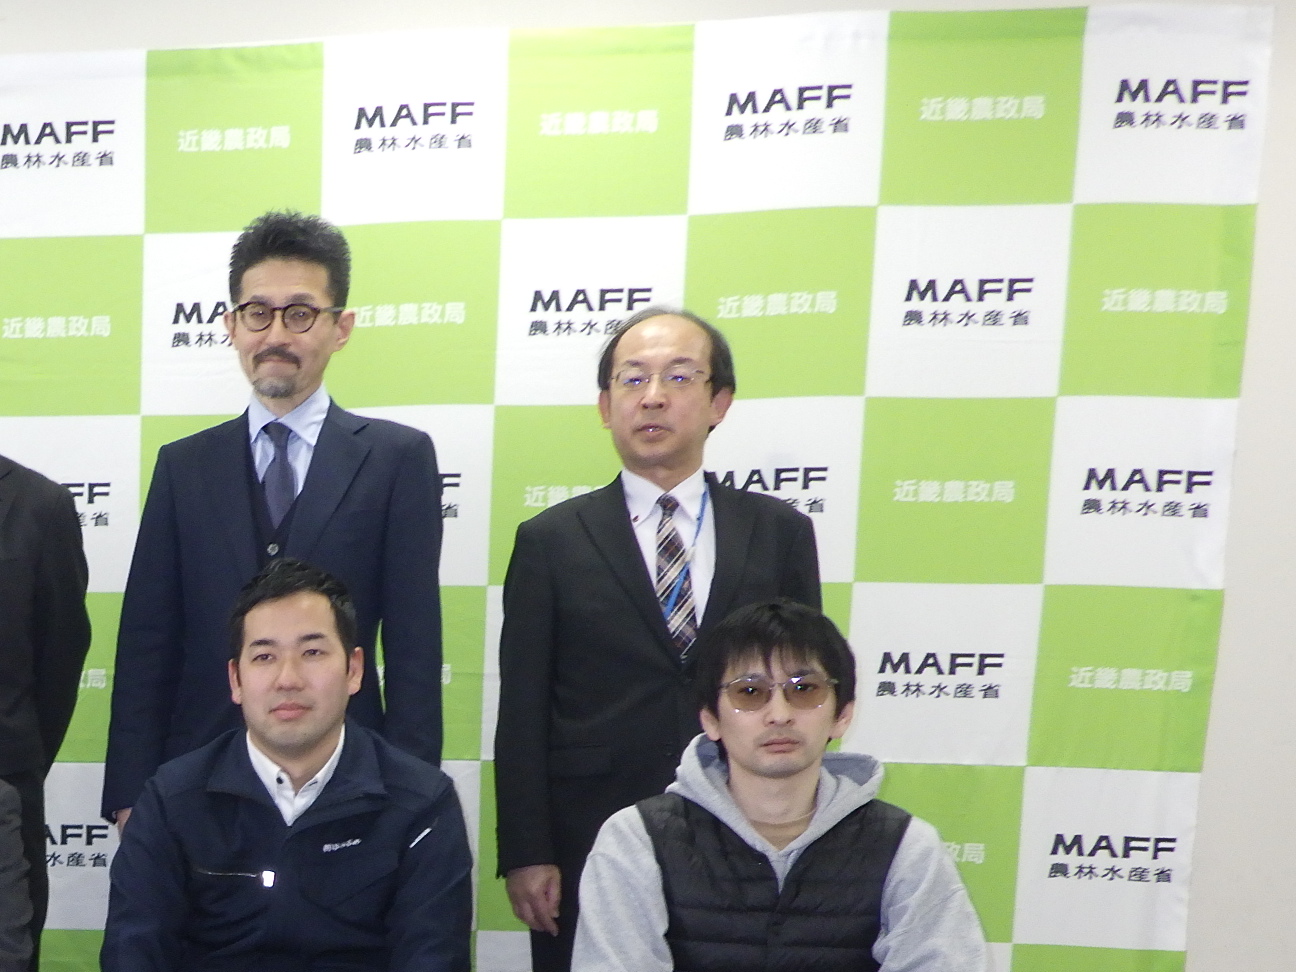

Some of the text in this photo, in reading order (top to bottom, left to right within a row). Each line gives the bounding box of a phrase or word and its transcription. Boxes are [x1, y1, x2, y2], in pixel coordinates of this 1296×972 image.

[726, 84, 852, 116] MAFF
[1115, 79, 1249, 104] MAFF
[355, 102, 474, 130] MAFF
[919, 96, 1045, 121] 近畿農政局
[1114, 111, 1245, 130] 農林水産省
[0, 120, 115, 145] MAFF
[540, 110, 658, 136] 近畿農政局
[724, 115, 848, 141] 農林水産省
[178, 125, 291, 152] 近畿農政局
[354, 134, 471, 154] 農林水産省
[1, 152, 113, 169] 農林水産省
[530, 288, 653, 313] MAFF
[905, 278, 1033, 302] MAFF
[1101, 289, 1227, 314] 近畿農政局
[172, 301, 231, 326] MA
[717, 291, 837, 318] 近畿農政局
[2, 316, 111, 339] 近畿農政局
[529, 320, 620, 337] 農林水産
[903, 310, 1028, 326] 農林水産省
[893, 480, 1015, 503] 近畿農政局
[1083, 468, 1213, 493] MAFF
[1081, 499, 1208, 518] 農林水産省
[878, 652, 1004, 675] MAFF
[876, 681, 999, 698] 農林水産省
[1068, 667, 1193, 692] 近畿農政局
[1050, 834, 1176, 860] MAFF
[47, 852, 108, 868] 水産省
[1048, 863, 1172, 883] 農林水産省
